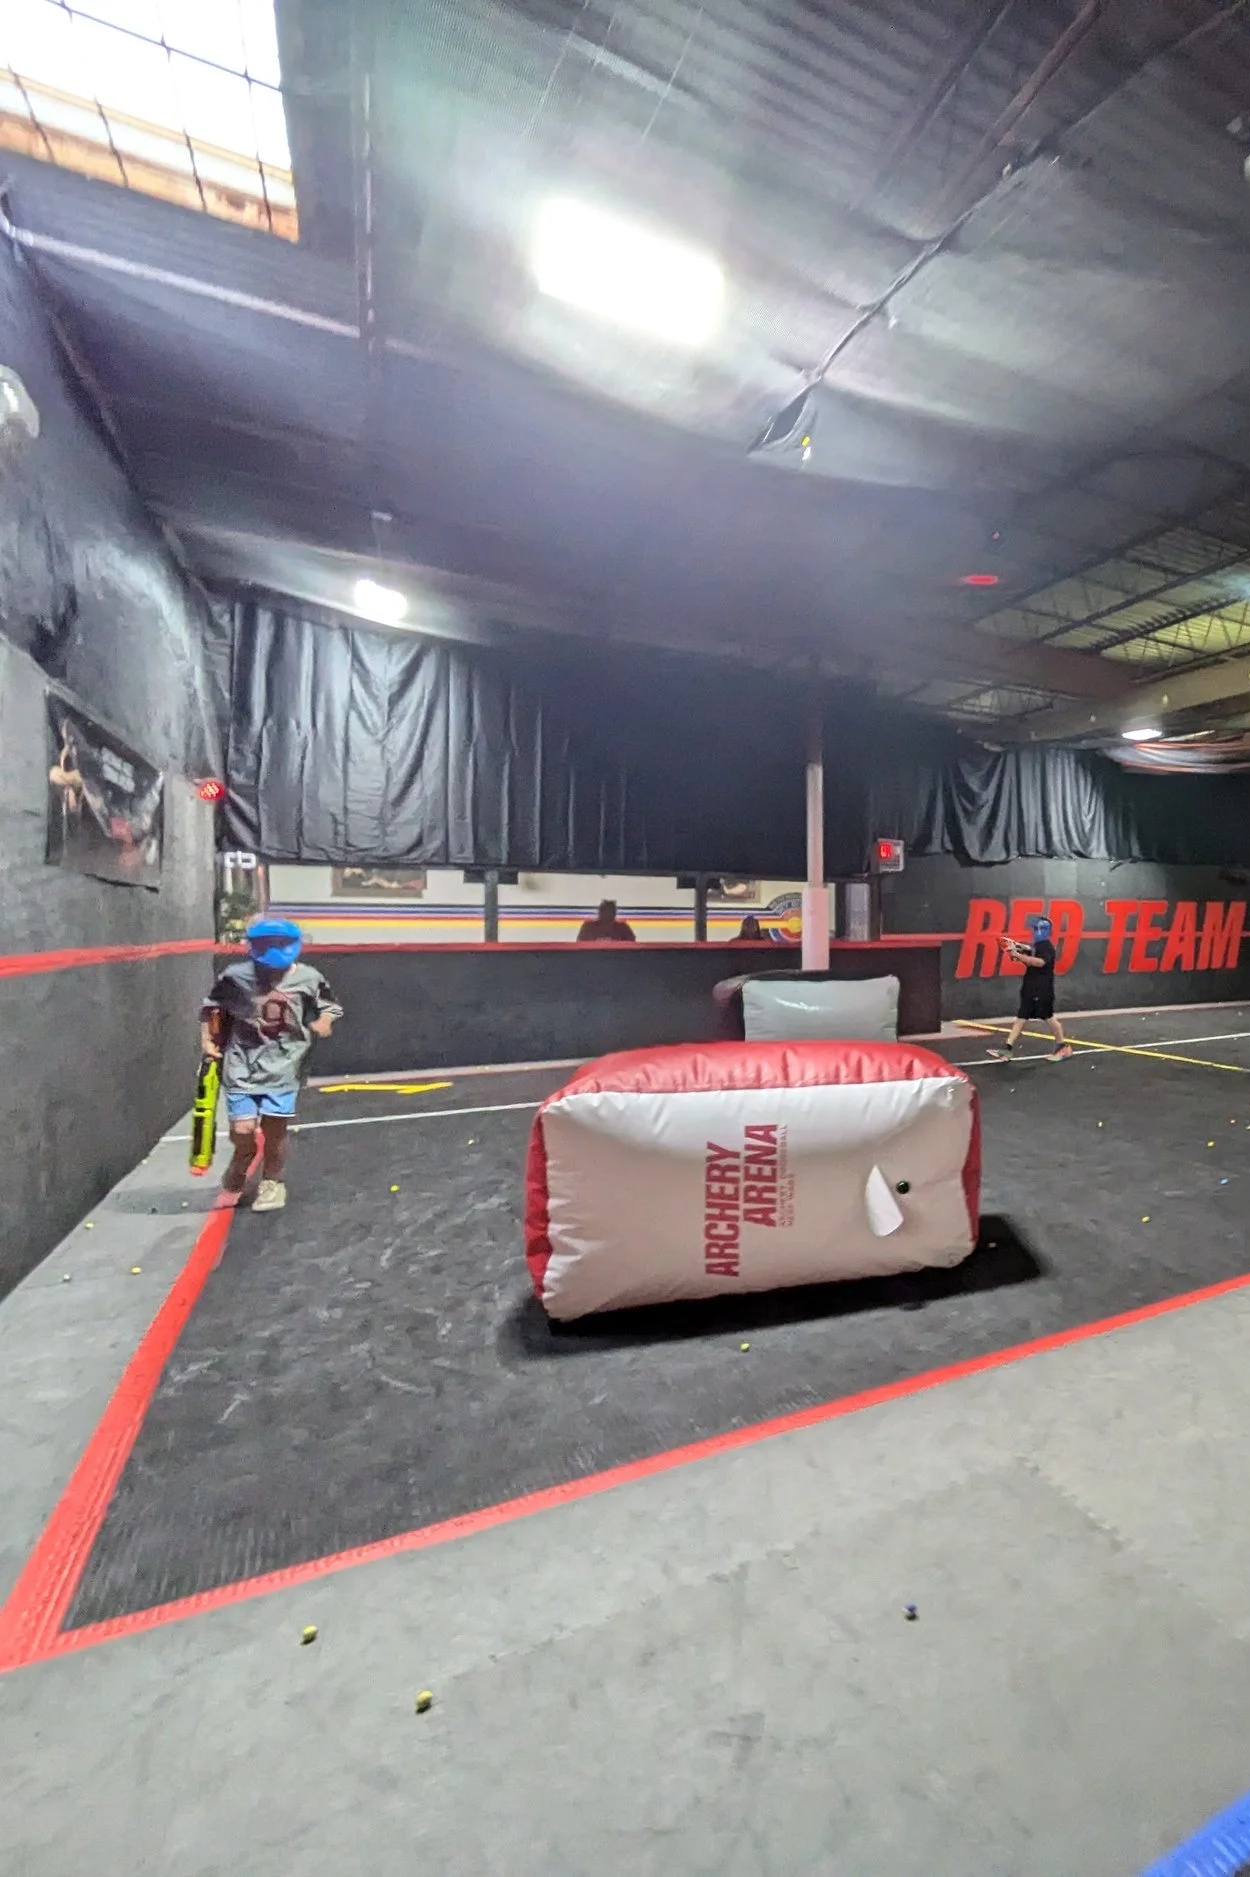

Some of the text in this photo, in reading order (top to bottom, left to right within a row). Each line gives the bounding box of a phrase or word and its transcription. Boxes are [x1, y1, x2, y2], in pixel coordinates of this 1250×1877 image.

[955, 898, 1246, 979] RED TEAM
[705, 1141, 740, 1277] ARCHERY
[743, 1124, 778, 1227] ARENA
